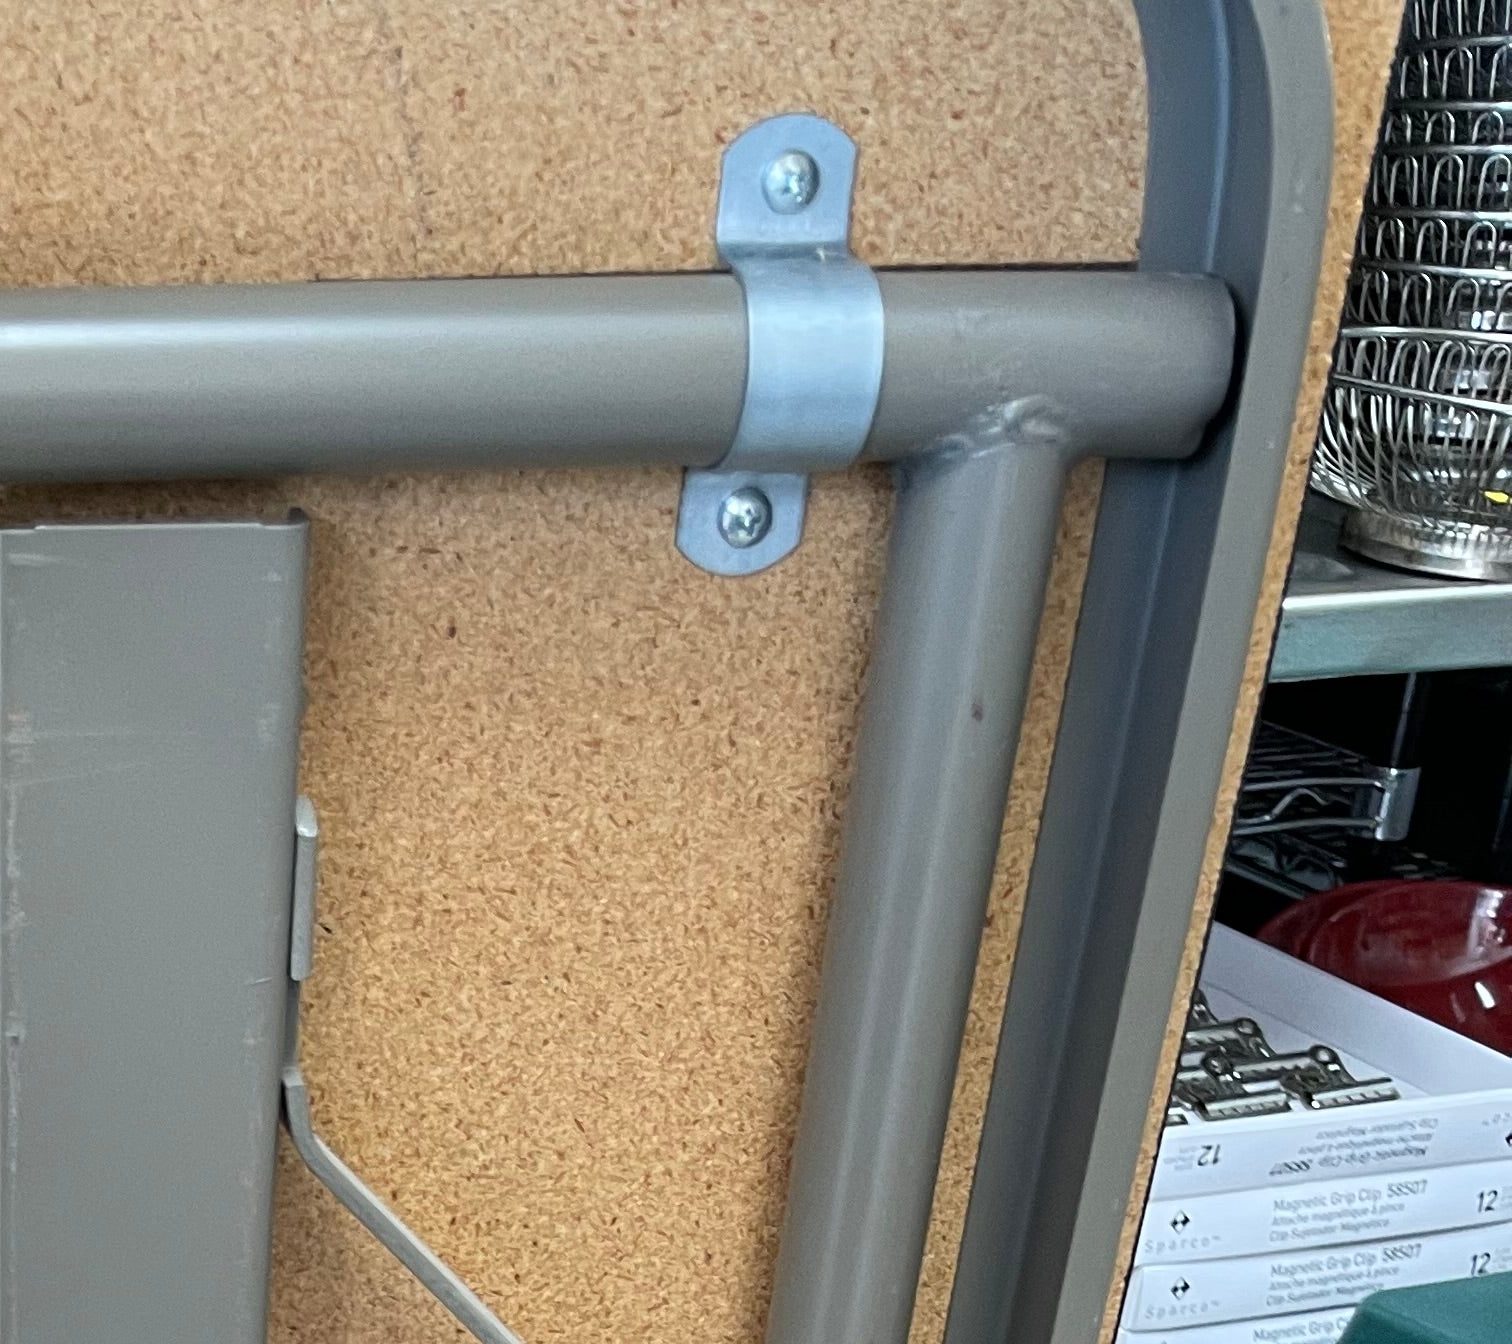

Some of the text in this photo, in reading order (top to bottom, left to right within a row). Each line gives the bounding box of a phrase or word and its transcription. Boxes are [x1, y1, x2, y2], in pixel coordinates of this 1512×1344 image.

[1197, 1144, 1222, 1167] 12
[1330, 1191, 1356, 1206] Grip
[1358, 1188, 1382, 1203] Clip
[1476, 1190, 1500, 1212] 12
[1326, 1256, 1352, 1270] Grip
[1353, 1252, 1378, 1267] Clip
[1470, 1252, 1492, 1276] 12
